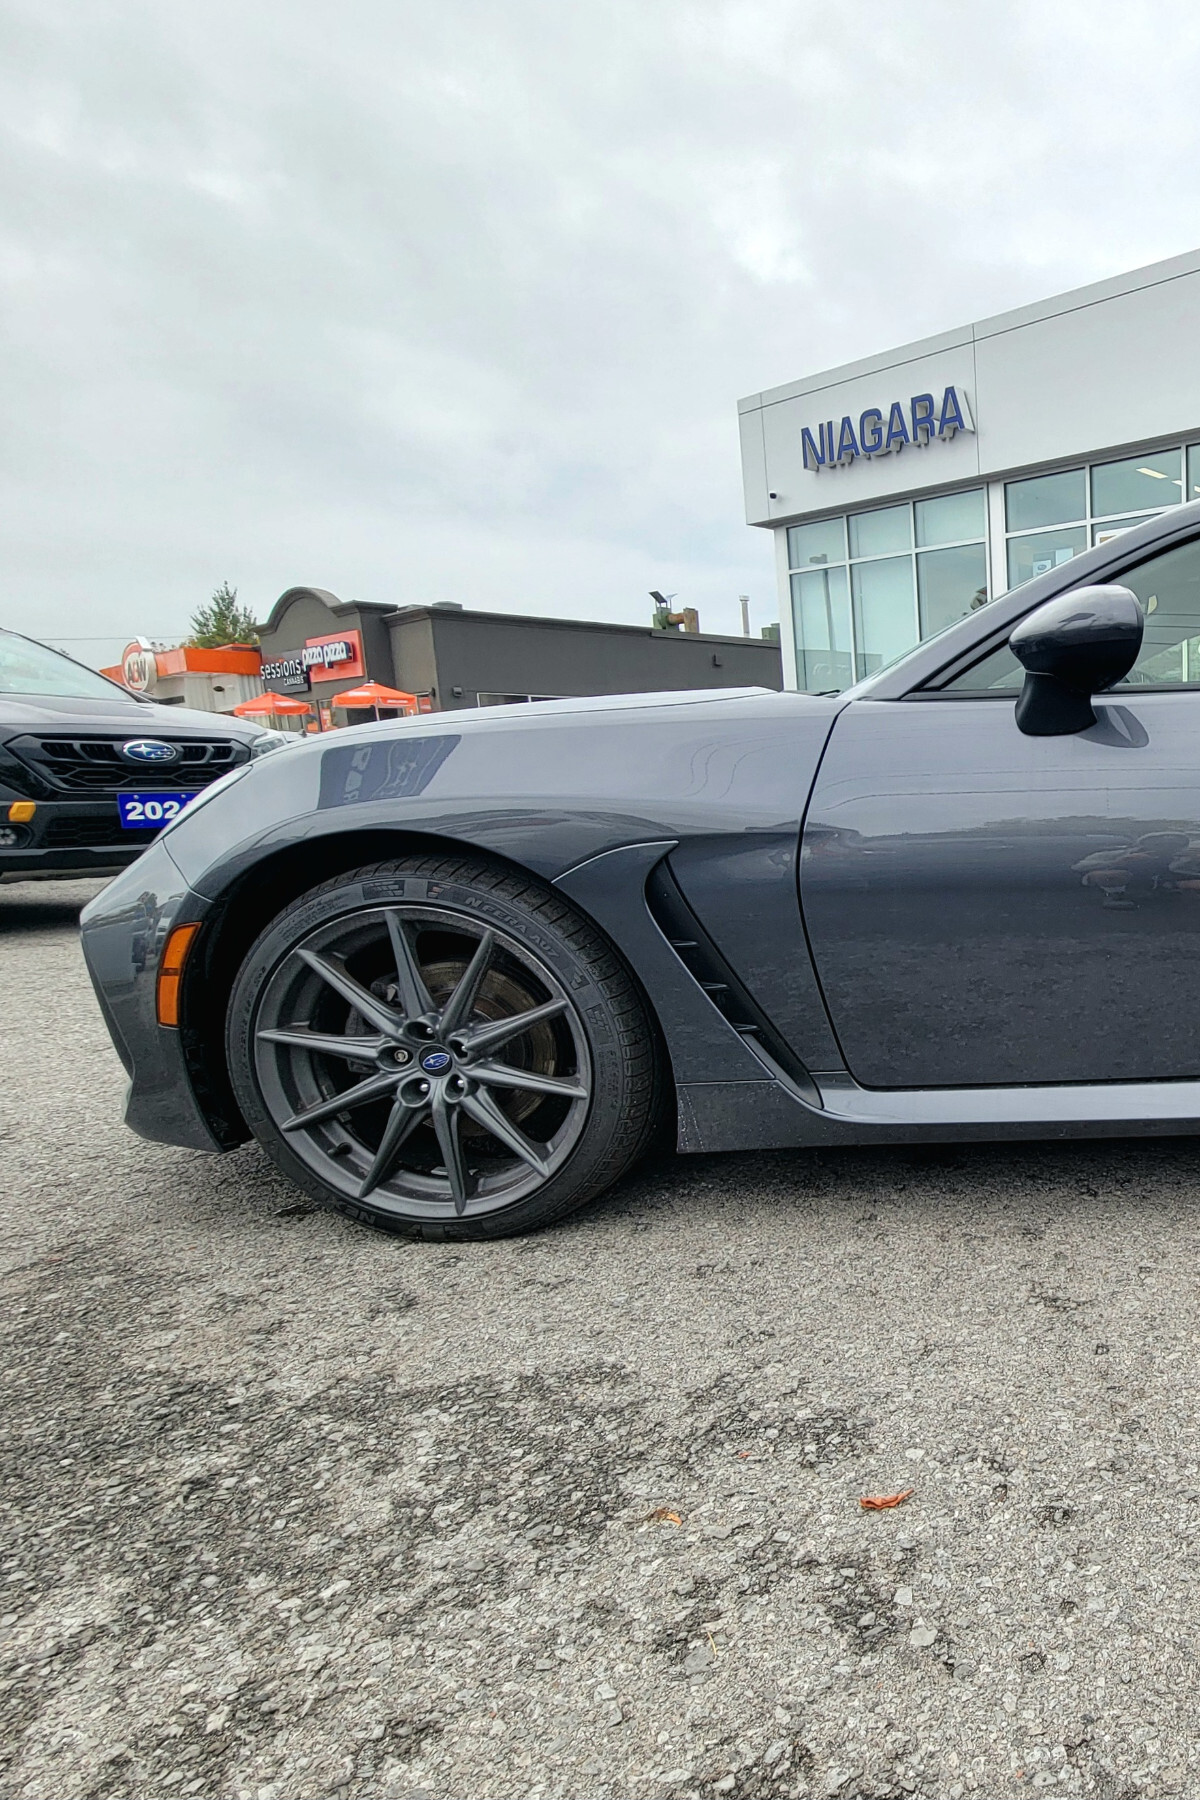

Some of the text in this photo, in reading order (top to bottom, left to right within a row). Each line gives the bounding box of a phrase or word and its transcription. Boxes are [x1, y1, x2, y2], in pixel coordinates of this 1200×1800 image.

[800, 385, 970, 470] NIAGARA
[302, 641, 347, 672] pizza pizza
[127, 657, 147, 683] A&W
[260, 658, 301, 679] sessions
[283, 675, 304, 686] CANNABIS
[125, 800, 191, 820] 202
